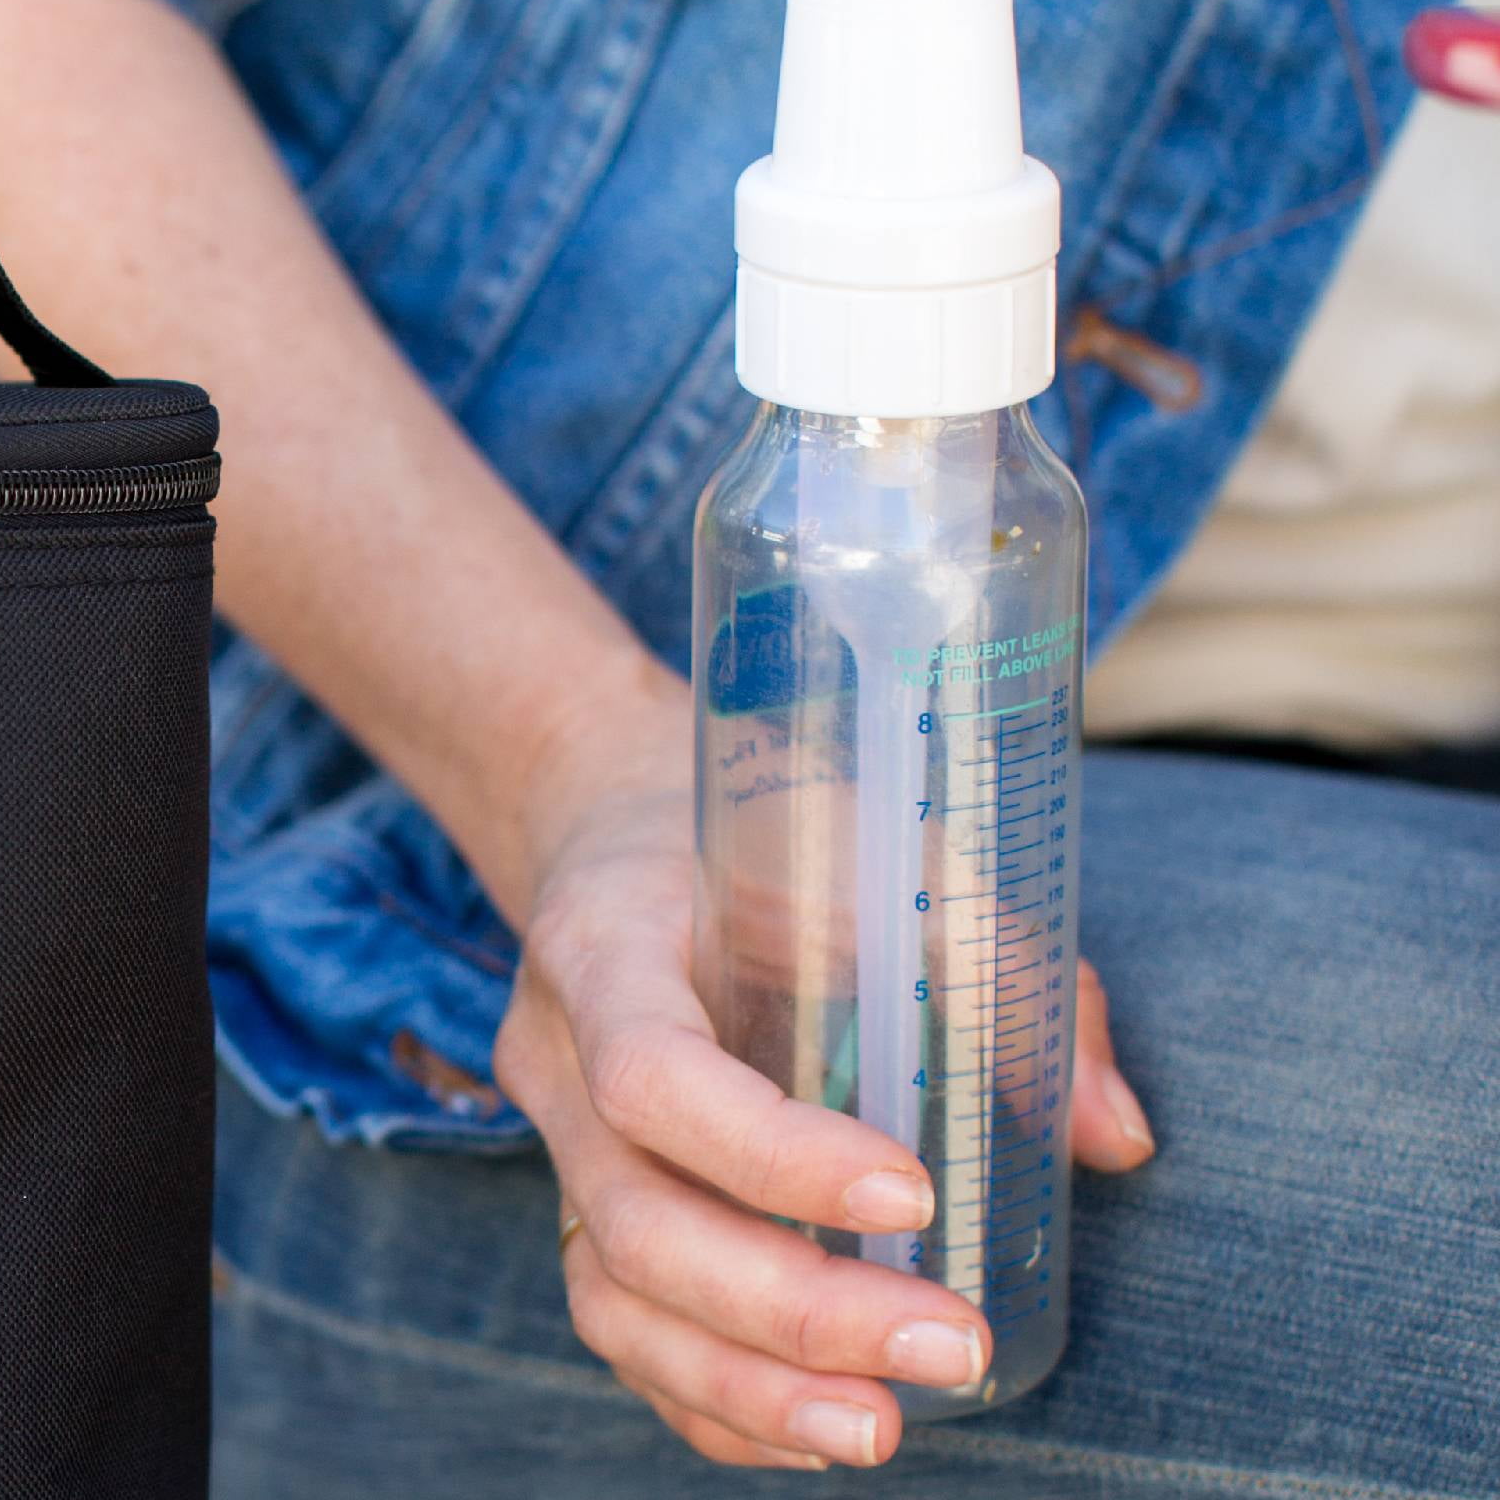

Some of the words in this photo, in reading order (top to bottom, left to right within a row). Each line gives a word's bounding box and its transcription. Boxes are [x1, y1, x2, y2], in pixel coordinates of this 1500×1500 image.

[893, 648, 920, 665] TO
[928, 638, 1019, 664] PREVENT
[1022, 621, 1067, 653] LEAKS
[902, 669, 944, 688] NOT
[951, 666, 993, 685] FILL
[998, 649, 1053, 679] ABOVE
[918, 712, 933, 734] 8
[1052, 707, 1068, 727] 230
[1051, 736, 1067, 756] 220
[1051, 764, 1067, 785] 210
[916, 801, 932, 822] 7
[915, 891, 930, 912] 6
[914, 980, 929, 1001] 5
[912, 1068, 927, 1088] 4
[909, 1241, 924, 1262] 2
